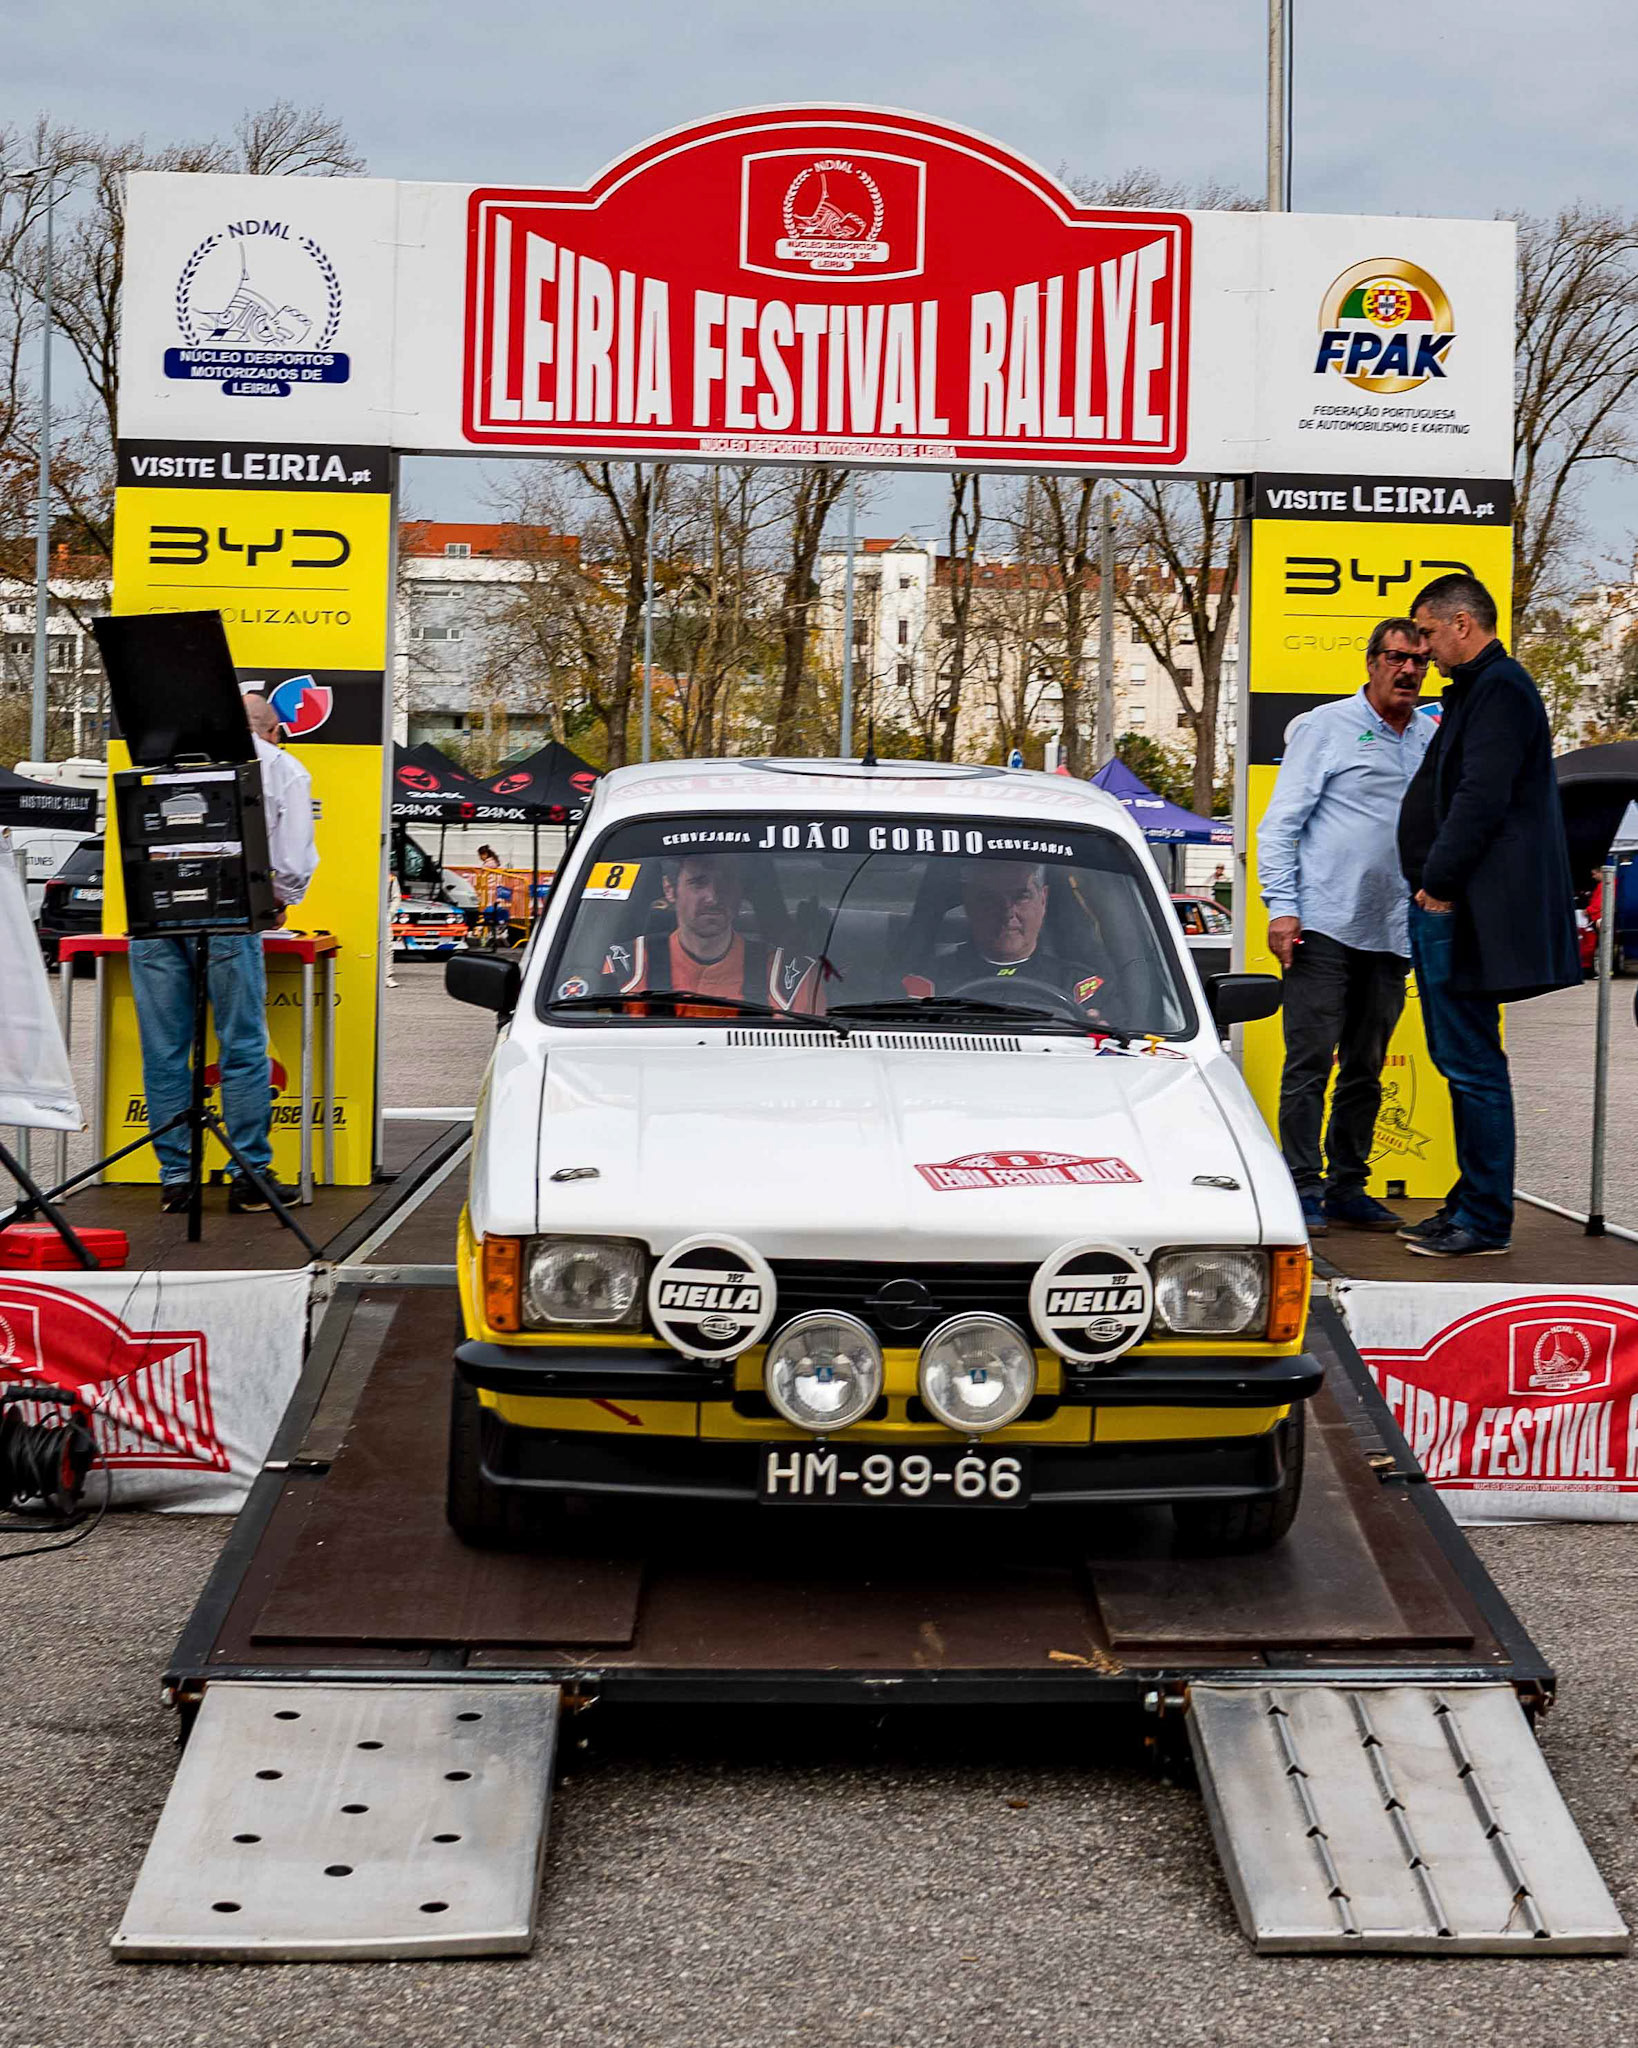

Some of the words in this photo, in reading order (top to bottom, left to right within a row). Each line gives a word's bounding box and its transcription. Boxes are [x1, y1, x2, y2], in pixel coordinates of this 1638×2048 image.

[813, 160, 853, 174] NDML
[228, 220, 291, 240] NDML
[489, 213, 672, 425] LEIRIA
[693, 289, 949, 435] FESTIVAL
[968, 236, 1168, 442] RALLYE
[244, 352, 335, 366] DESPORTOS
[1313, 331, 1458, 378] FPAK
[190, 366, 299, 380] MOTORIZADOS
[301, 369, 323, 381] DE
[232, 382, 281, 395] LEIRIA
[1313, 404, 1379, 419] FEDERAÇÃO
[1381, 408, 1456, 420] PORTUGUESA
[1299, 419, 1314, 430] DE
[1316, 420, 1408, 433] AUTOMOBILISMO
[1412, 423, 1420, 433] E
[1421, 423, 1471, 435] KARTING
[749, 440, 816, 454] DESPORTOS
[818, 443, 899, 457] MOTORIZADOS
[901, 446, 917, 458] DE
[919, 446, 957, 459] LEIRIA
[131, 456, 215, 478] VISITE
[221, 452, 371, 485] LEIRIA.pt
[1266, 489, 1347, 511] VISITE
[1352, 486, 1495, 518] LEIRIA.pt
[148, 525, 350, 568] BYD
[662, 831, 751, 846] CERVEJARIA
[759, 822, 850, 850] JOÃO
[869, 826, 984, 855] GORDO
[987, 839, 1074, 857] CERVEJARIA
[606, 865, 624, 889] 8
[1007, 1155, 1029, 1166] 8
[926, 1167, 996, 1189] LEIRIA
[987, 1168, 1073, 1187] FESTIVAL
[1065, 1160, 1135, 1183] RALLYE
[660, 1284, 759, 1310] HELLA
[1048, 1289, 1142, 1313] HELLA
[1471, 1400, 1616, 1478] FESTIVAL
[766, 1451, 1022, 1499] HM-99-66
